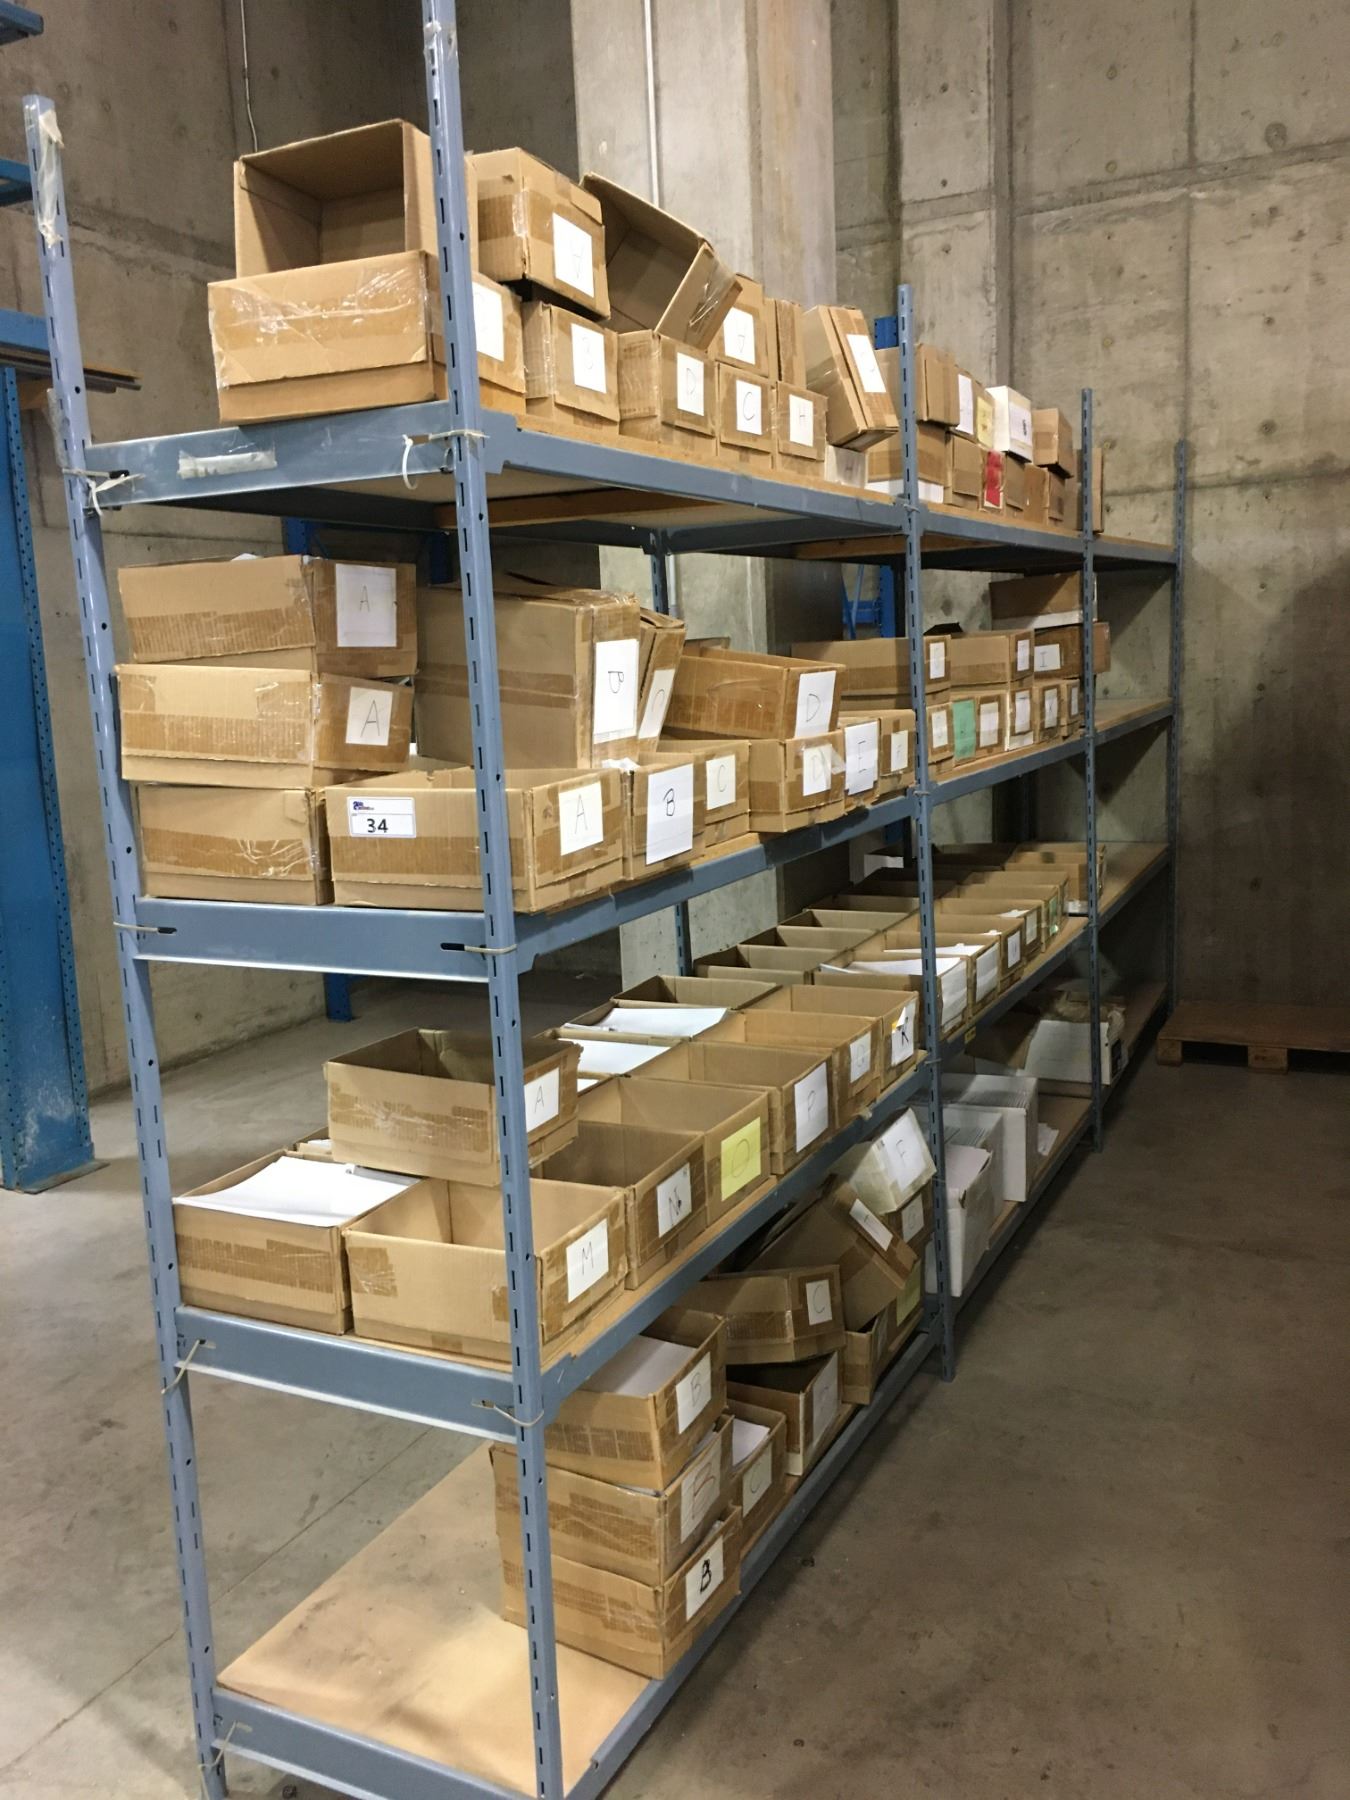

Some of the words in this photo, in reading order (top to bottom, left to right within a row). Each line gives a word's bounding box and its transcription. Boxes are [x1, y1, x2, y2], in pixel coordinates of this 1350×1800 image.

[742, 390, 756, 421] C
[359, 585, 370, 612] A
[360, 700, 380, 737] A
[806, 693, 821, 723] D
[716, 763, 727, 793] C
[574, 794, 588, 835] A
[662, 787, 676, 818] B
[366, 818, 388, 833] 34
[534, 1085, 545, 1115] A
[807, 1090, 817, 1122] P
[582, 1241, 594, 1276] M
[812, 1284, 826, 1314] C
[700, 1558, 713, 1594] B
